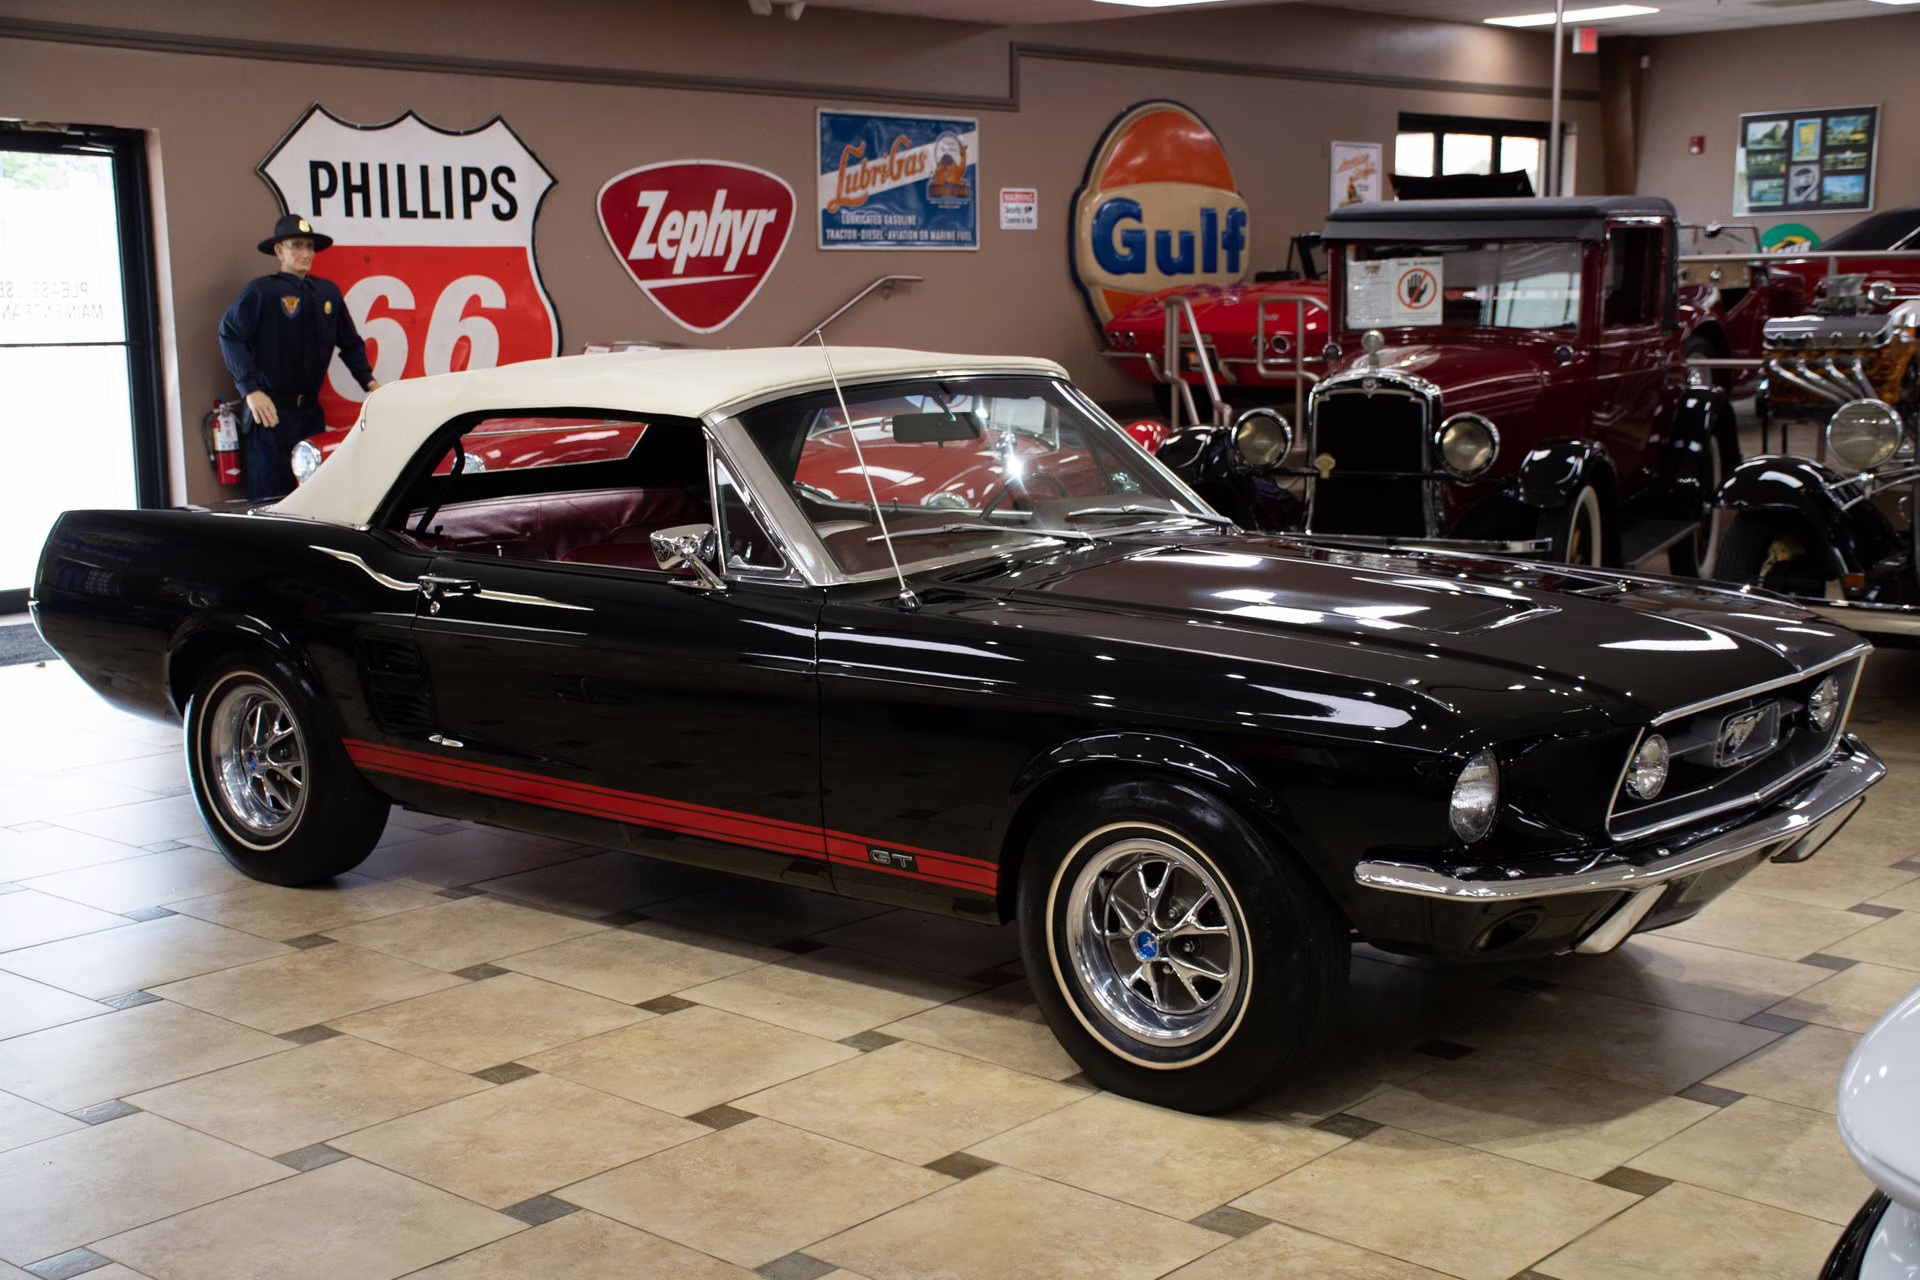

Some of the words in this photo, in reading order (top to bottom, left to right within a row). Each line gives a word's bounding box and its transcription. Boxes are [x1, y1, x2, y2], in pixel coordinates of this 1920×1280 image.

[309, 160, 518, 221] PHILLIPS
[841, 213, 882, 225] LUBRICATED
[883, 214, 917, 226] GASOLINE
[627, 188, 777, 275] Zephyr
[826, 228, 857, 241] TRACTOR
[860, 229, 885, 241] DIESEL
[887, 229, 918, 241] AVIATION
[919, 230, 930, 241] OR
[930, 230, 956, 242] MARINE
[956, 230, 972, 242] FUEL
[1091, 196, 1248, 276] Gulf
[327, 274, 507, 404] 66
[870, 849, 913, 868] GT
